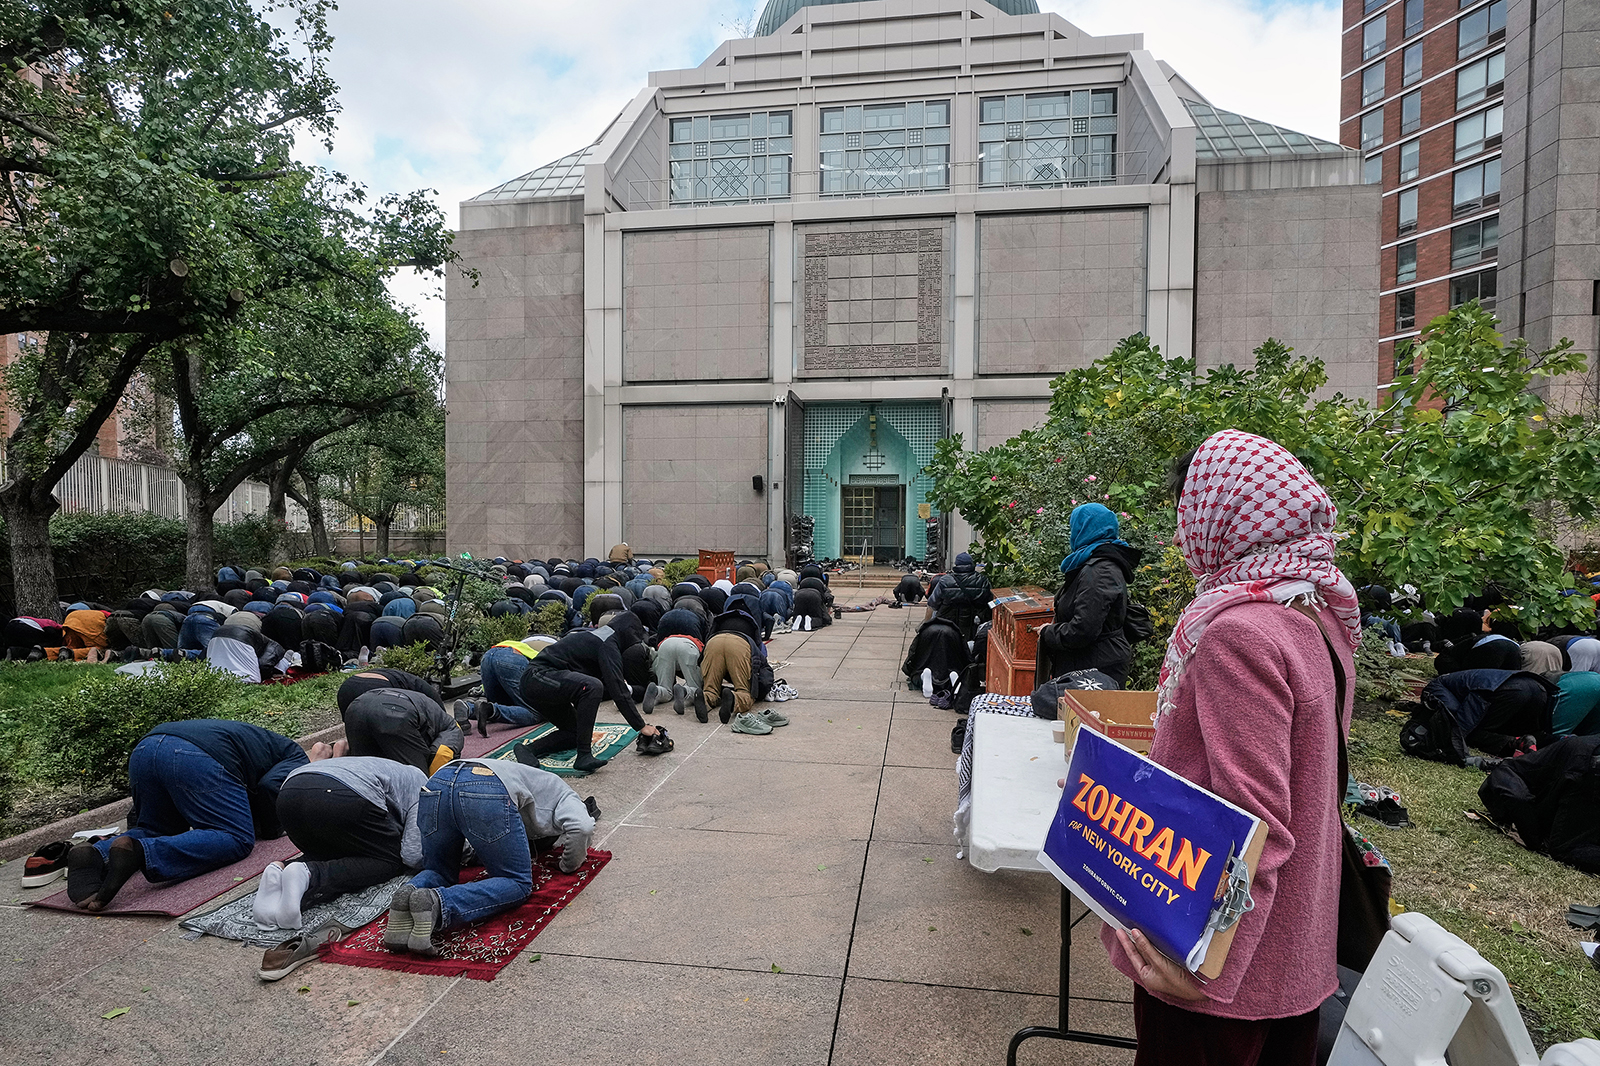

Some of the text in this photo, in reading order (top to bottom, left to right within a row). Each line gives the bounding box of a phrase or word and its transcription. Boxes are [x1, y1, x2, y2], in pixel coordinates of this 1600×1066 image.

[1117, 730, 1147, 738] BANANAS
[1068, 820, 1180, 905] FOR NEW YORK CITY
[1071, 773, 1212, 891] ZOHRAN
[1082, 863, 1128, 906] ZOHRANFORNYC.COM
